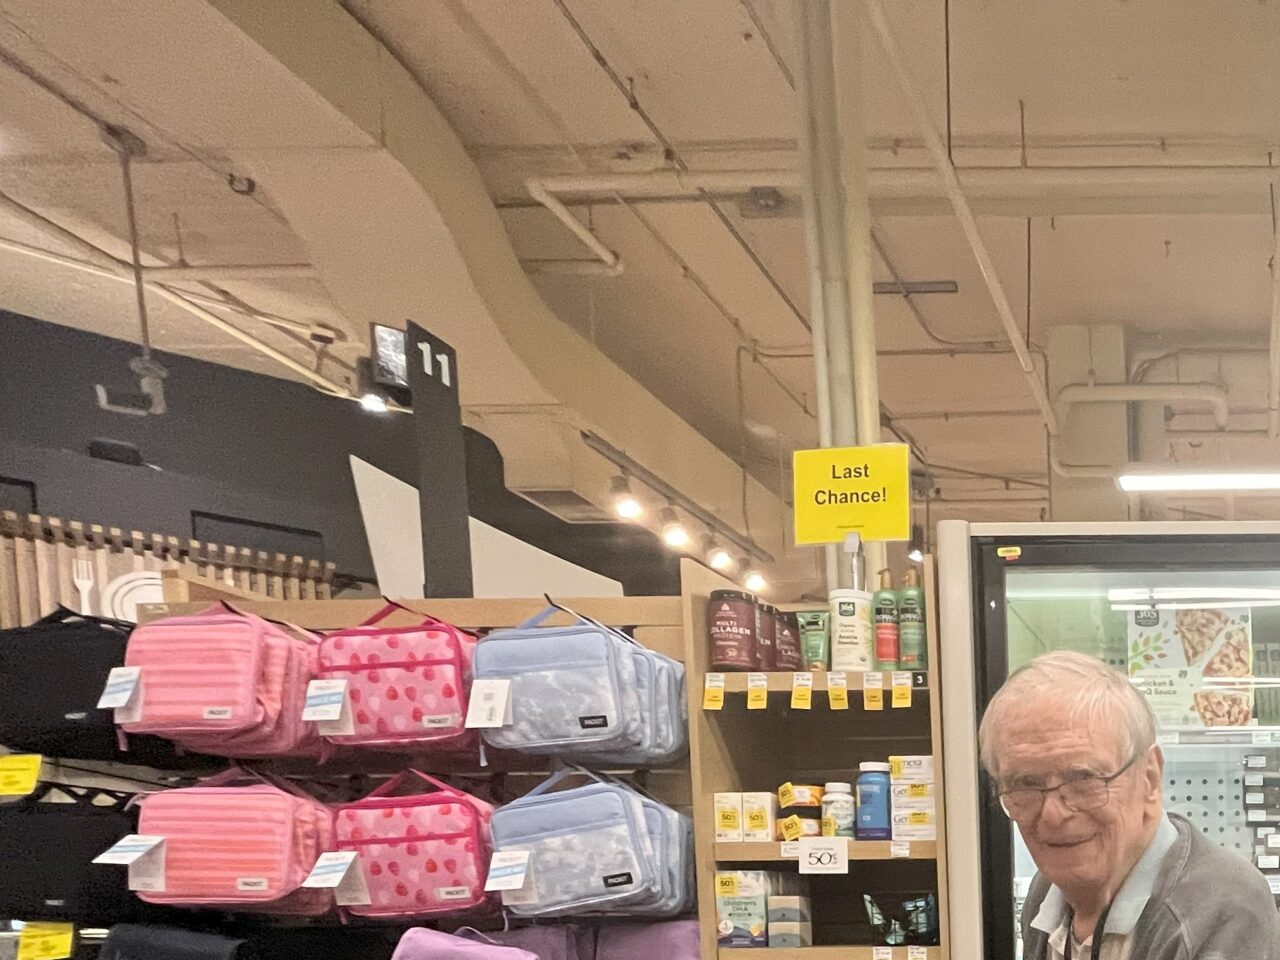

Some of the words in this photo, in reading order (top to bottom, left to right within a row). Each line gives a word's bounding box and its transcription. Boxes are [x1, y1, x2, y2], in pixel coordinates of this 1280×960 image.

[417, 341, 451, 387] 11
[831, 463, 870, 479] Last
[814, 487, 887, 505] Chance!
[917, 675, 923, 684] 3
